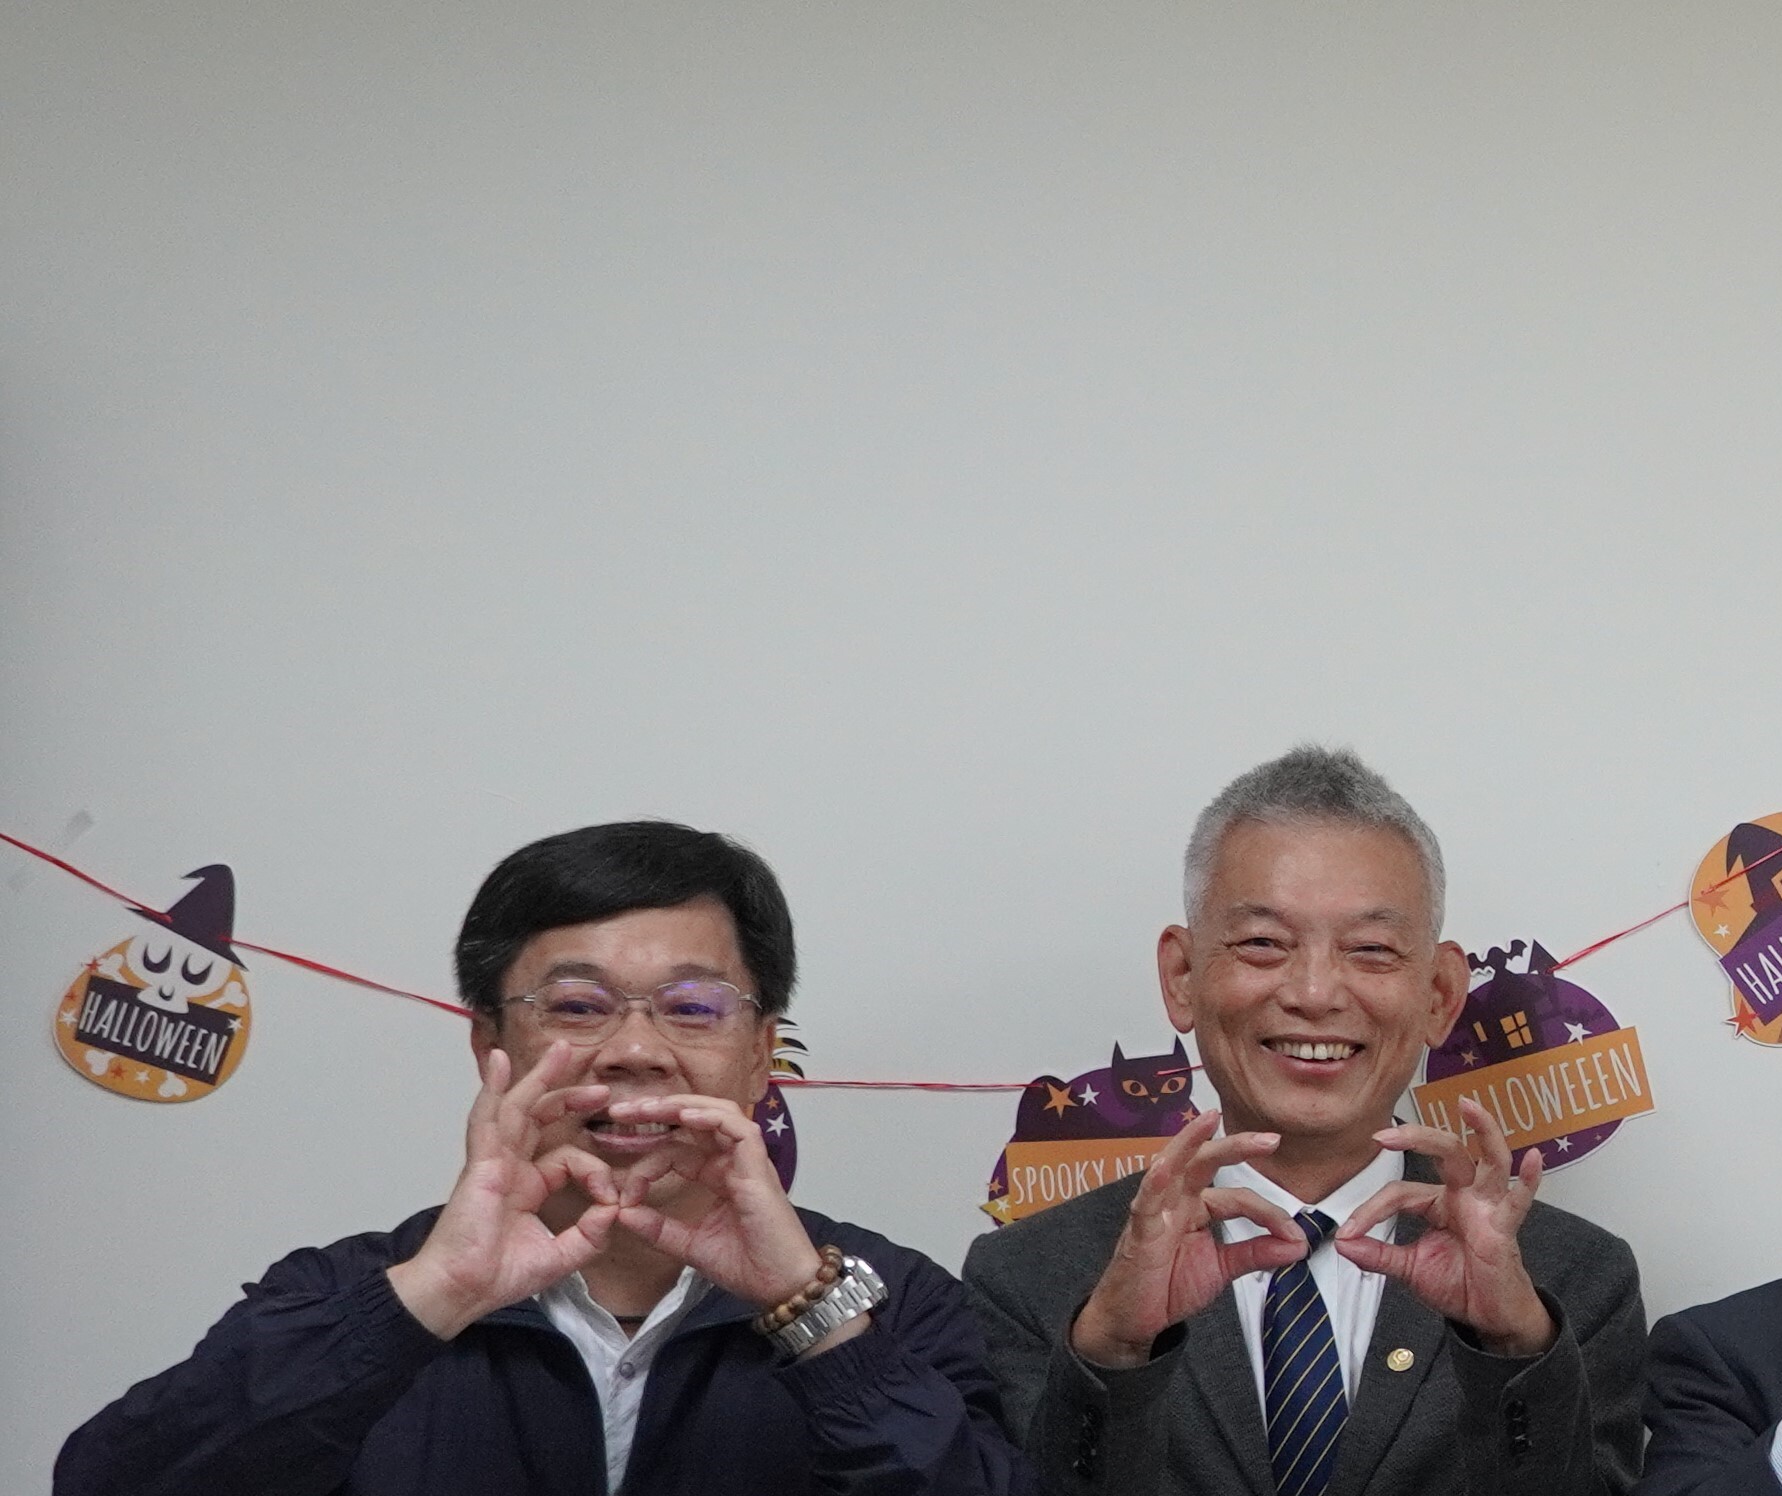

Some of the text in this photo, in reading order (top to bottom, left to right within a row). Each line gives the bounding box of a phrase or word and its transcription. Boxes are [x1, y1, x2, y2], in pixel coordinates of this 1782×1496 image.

[78, 990, 228, 1075] HALLOWEEN
[1428, 1042, 1642, 1147] HALOWEEEN
[1012, 1154, 1104, 1205] SPOOKY
